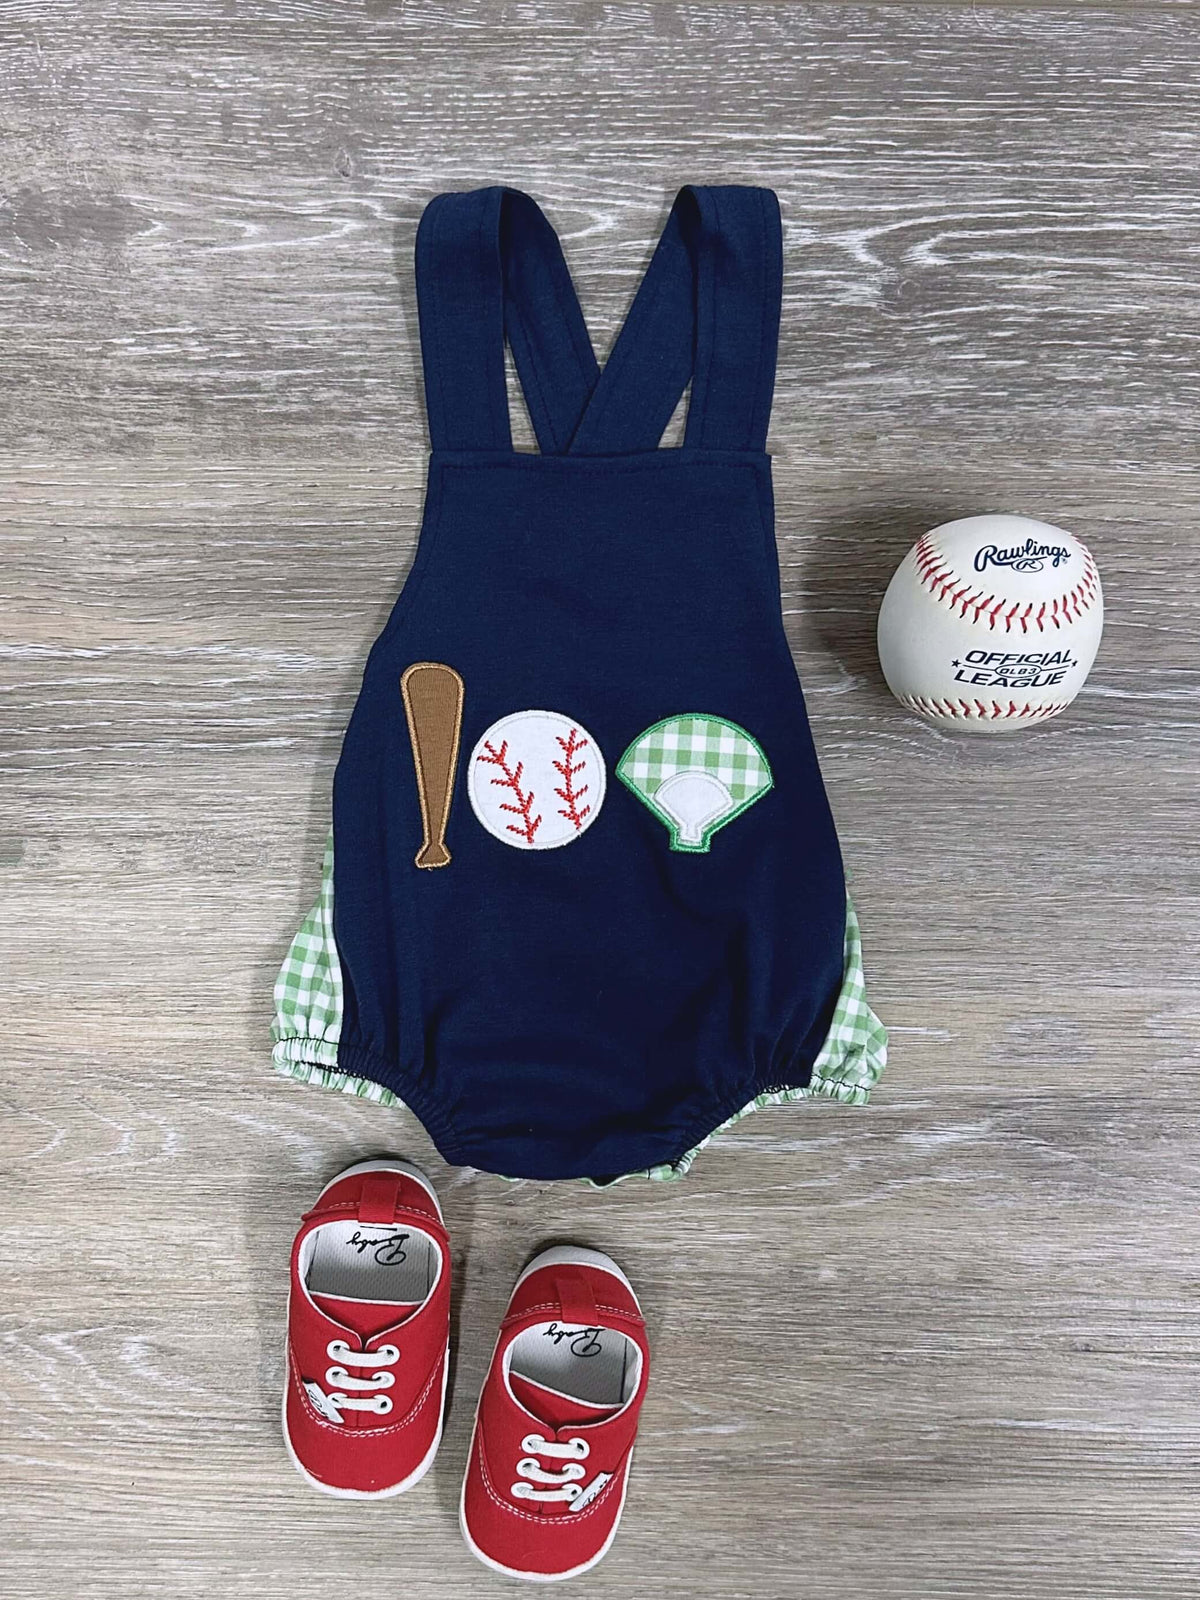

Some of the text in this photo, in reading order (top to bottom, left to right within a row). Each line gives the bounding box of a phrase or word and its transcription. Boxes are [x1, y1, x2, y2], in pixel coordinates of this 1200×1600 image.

[974, 538, 1071, 572] Rawlings
[965, 650, 1072, 666] OFFICIAL
[954, 669, 1067, 688] LEAGUE
